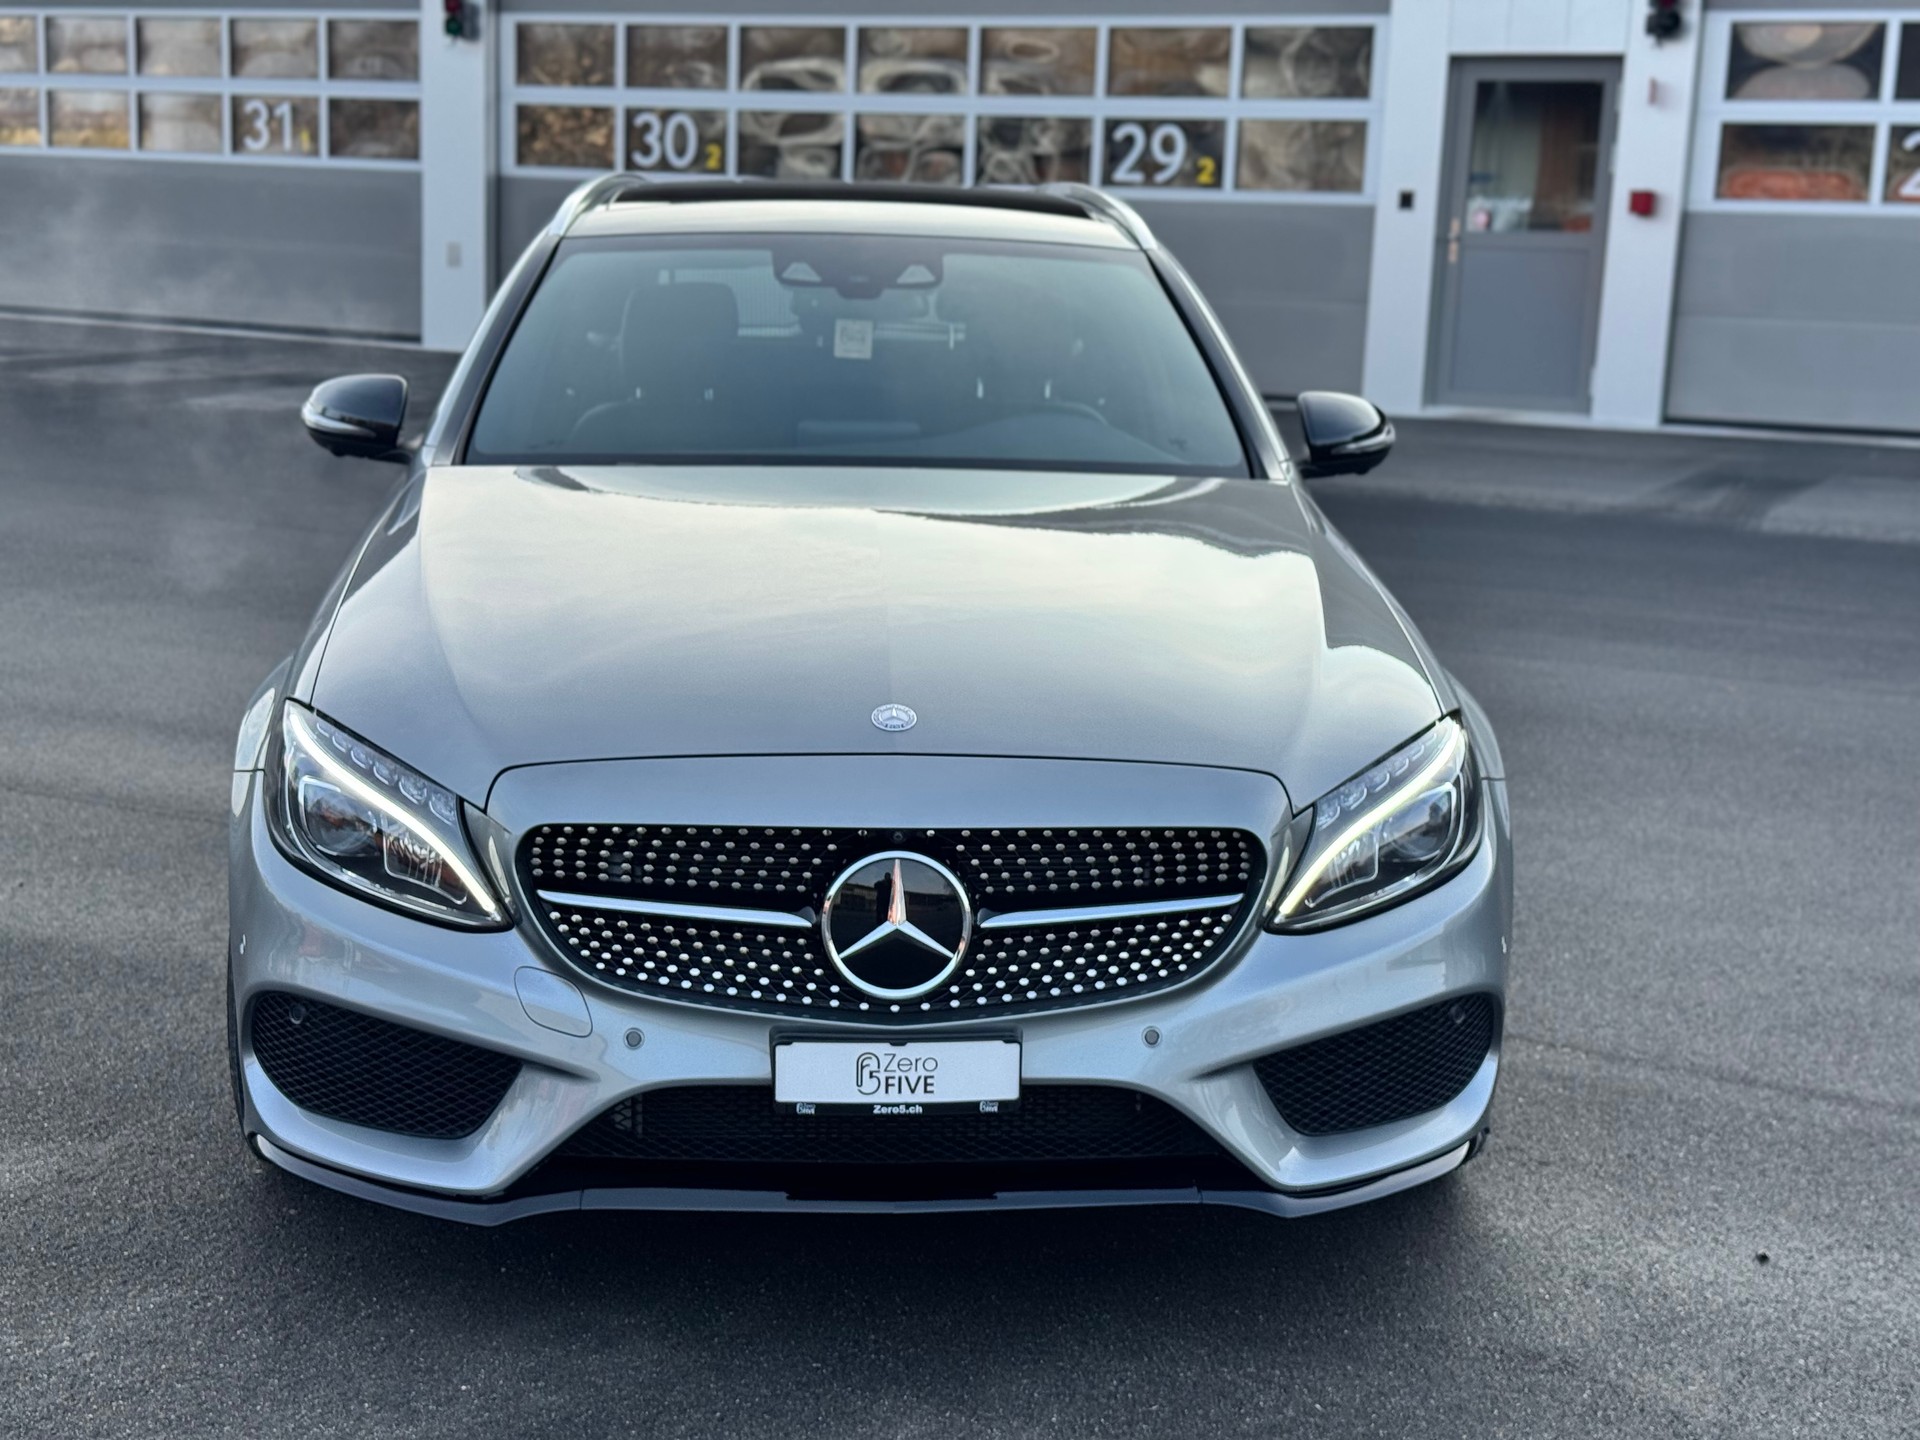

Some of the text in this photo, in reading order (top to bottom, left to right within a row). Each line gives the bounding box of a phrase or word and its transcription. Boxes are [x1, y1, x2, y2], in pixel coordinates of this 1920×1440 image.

[243, 99, 293, 152] 31
[632, 112, 721, 170] 30 2
[1111, 122, 1216, 185] 29 2
[883, 1053, 938, 1072] Zero
[884, 1074, 936, 1095] FIVE
[873, 1104, 923, 1115] Zero5.ch
